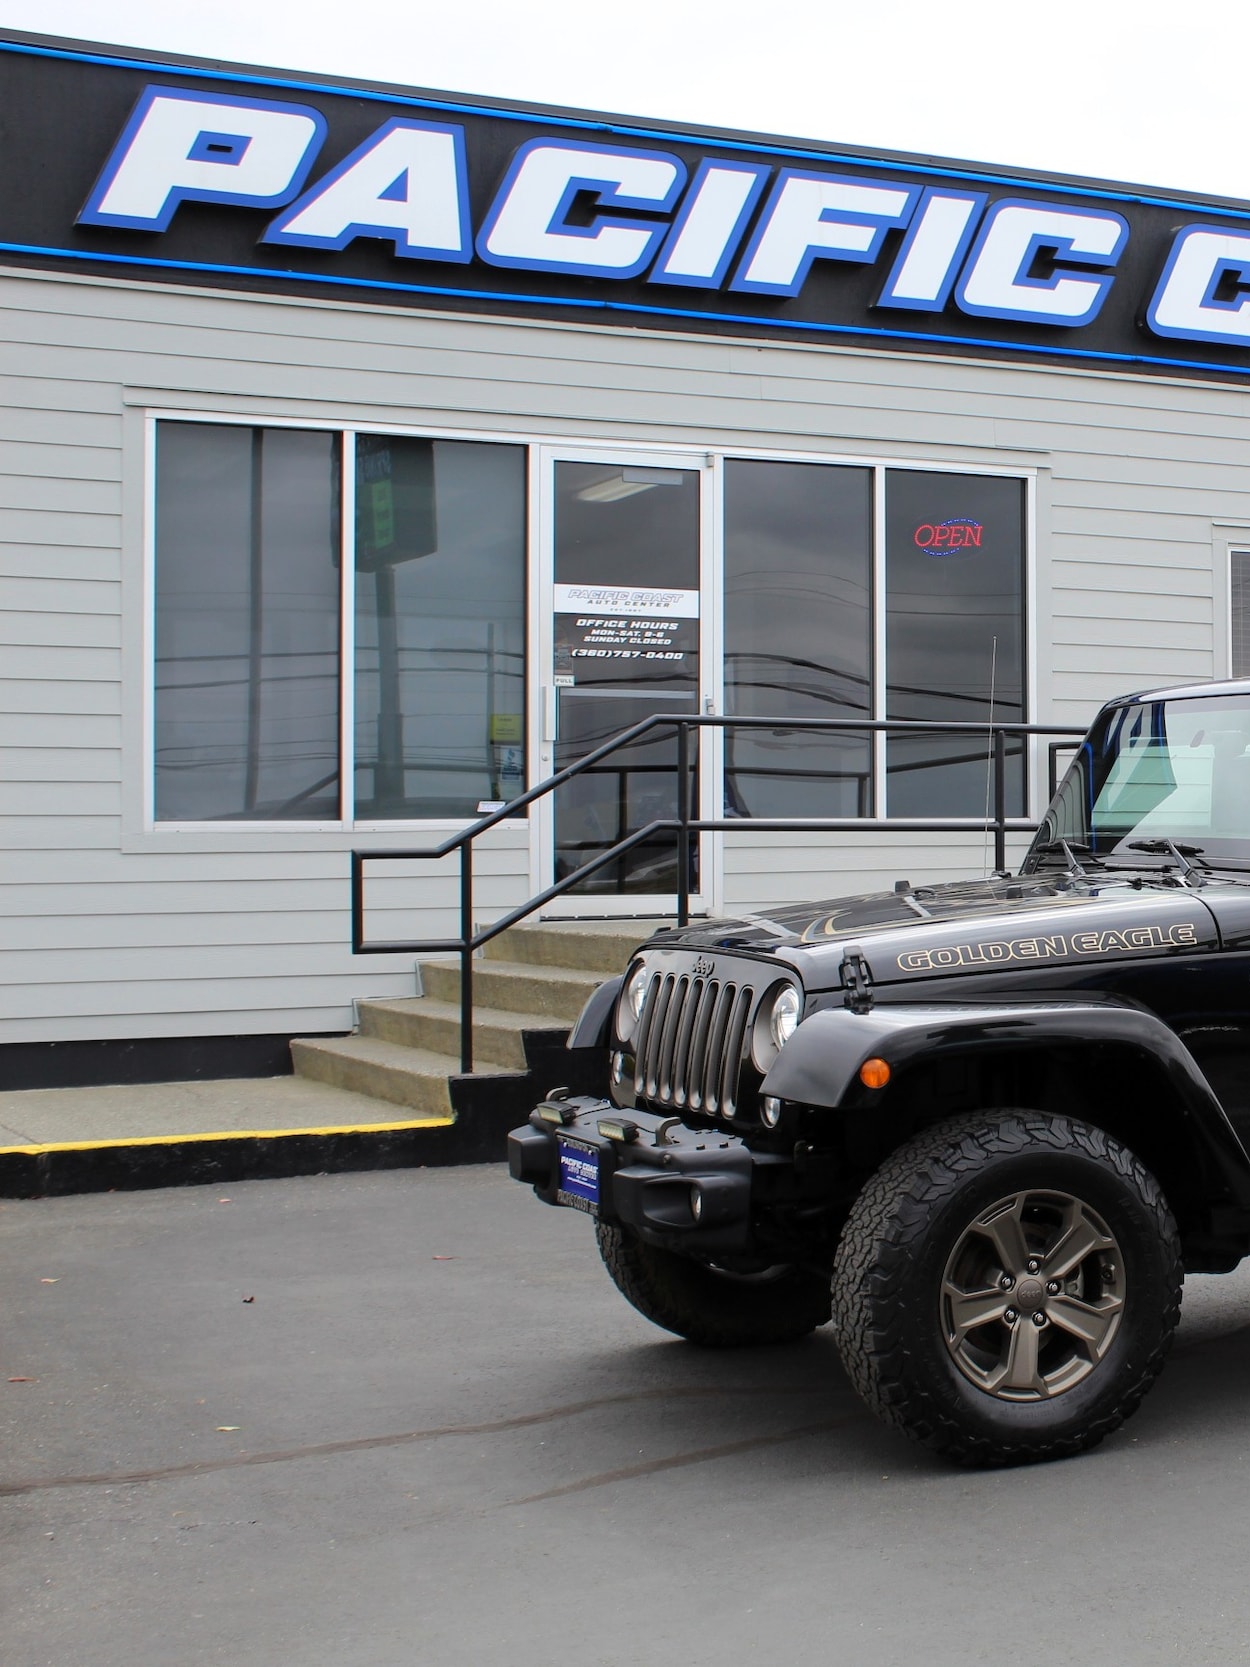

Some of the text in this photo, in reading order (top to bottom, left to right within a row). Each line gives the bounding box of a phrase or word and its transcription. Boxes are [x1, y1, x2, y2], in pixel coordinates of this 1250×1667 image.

[76, 84, 1131, 327] PACIFIC
[914, 524, 983, 547] OPEN
[568, 589, 684, 603] PACIFIC COAST
[576, 618, 679, 630] OFFICE HOURS
[590, 629, 641, 637] MON-SAT.
[583, 635, 672, 645] SUNDAY CLOSED
[897, 923, 1198, 972] GOLDEN EAGLE
[692, 955, 715, 978] Jeep
